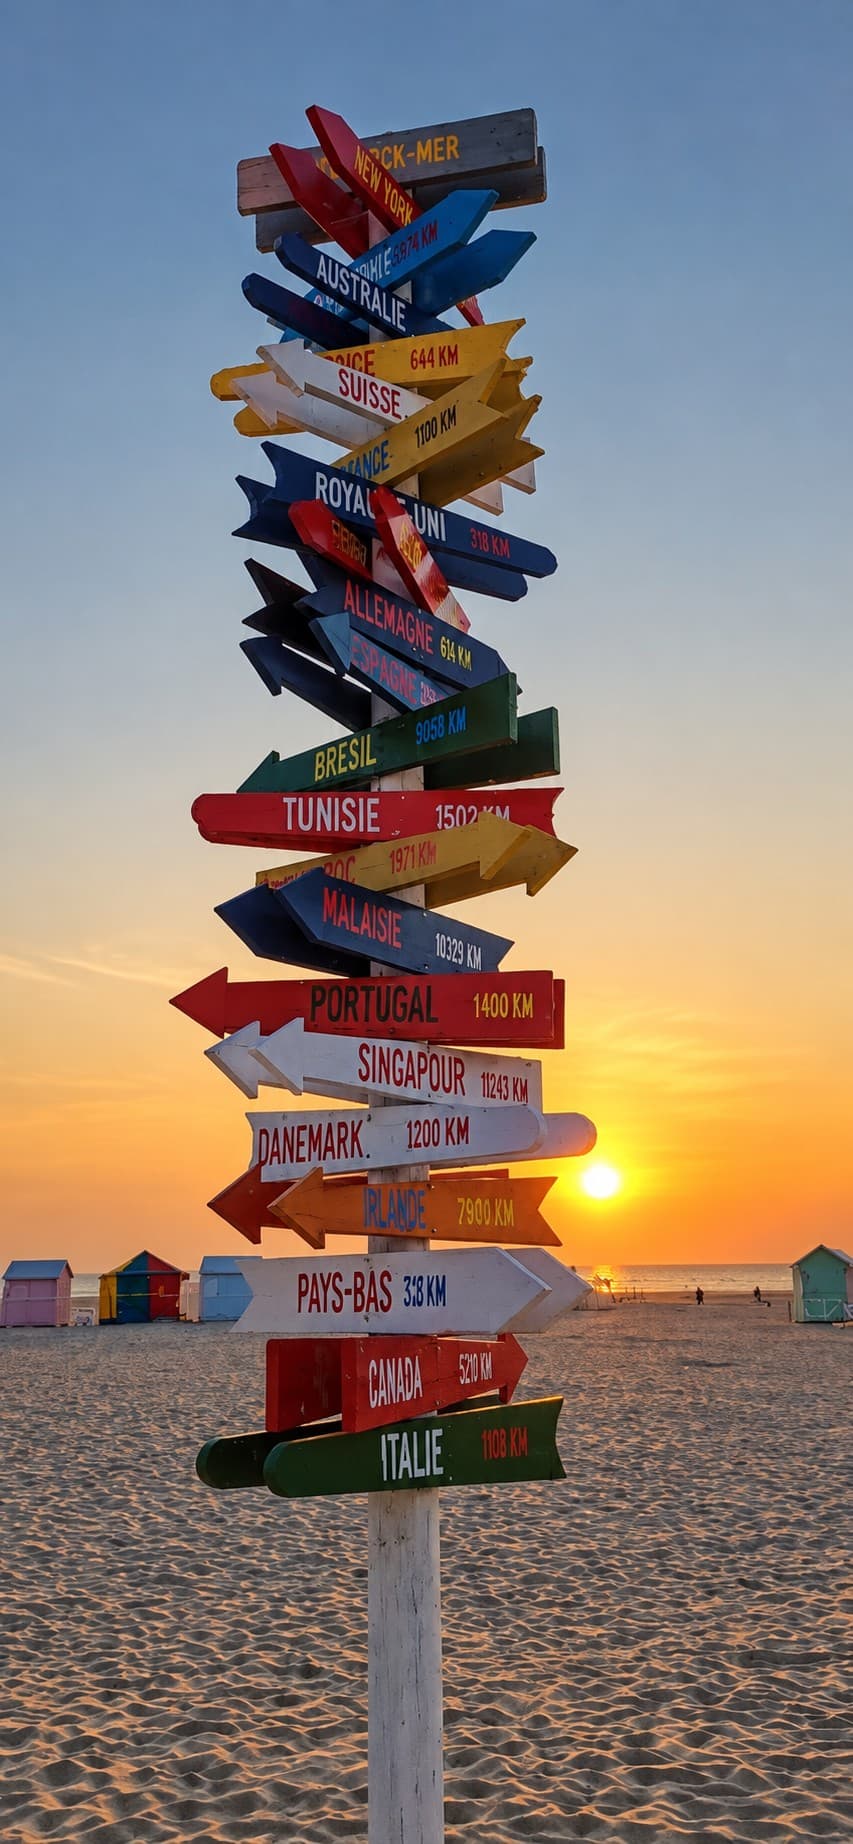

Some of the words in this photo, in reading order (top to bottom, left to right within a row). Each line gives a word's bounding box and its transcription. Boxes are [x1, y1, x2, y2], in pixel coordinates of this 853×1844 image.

[354, 145, 382, 193] NEW
[384, 177, 414, 226] YORK
[422, 220, 438, 248] KM
[316, 254, 406, 332] AUSTRALIE
[410, 347, 435, 370] 644
[438, 344, 458, 367] KM
[338, 368, 402, 419] SUISSE
[414, 416, 437, 448] 1100
[440, 405, 457, 434] KM
[470, 527, 489, 552] 318
[492, 535, 511, 559] KM
[344, 579, 434, 655] ALLEMAGNE
[440, 636, 456, 663] 614
[458, 645, 472, 671] KM
[351, 635, 417, 704] ESPAGNE
[314, 734, 377, 782] BRESIL
[416, 716, 445, 745] 9058
[448, 706, 466, 734] KM
[283, 797, 380, 832] TUNISIE
[435, 804, 478, 830] 1502
[482, 805, 510, 821] M
[389, 843, 415, 875] 1971
[419, 840, 437, 866] KM
[323, 887, 402, 949] MALAISIE
[435, 933, 464, 964] 10329
[467, 943, 482, 971] KM
[311, 984, 438, 1023] PORTUGAL
[473, 993, 508, 1018] 1400
[512, 993, 533, 1019] KM
[358, 1043, 465, 1096] SINGAPOUR
[480, 1072, 509, 1101] 11243
[512, 1077, 528, 1105] KM
[258, 1120, 364, 1167] DANEMARK
[406, 1118, 441, 1149] 1200
[445, 1116, 469, 1145] KM
[363, 1187, 426, 1232] IRLANDE
[457, 1197, 491, 1226] 7900
[494, 1198, 514, 1227] KM
[298, 1270, 392, 1313] PAYS-BAS
[426, 1274, 446, 1307] KM
[368, 1356, 423, 1409] CANADA
[458, 1353, 478, 1385] 5210
[480, 1351, 492, 1380] KM
[380, 1428, 444, 1481] ITALIE
[481, 1429, 506, 1460] 1108
[509, 1427, 528, 1458] KM
